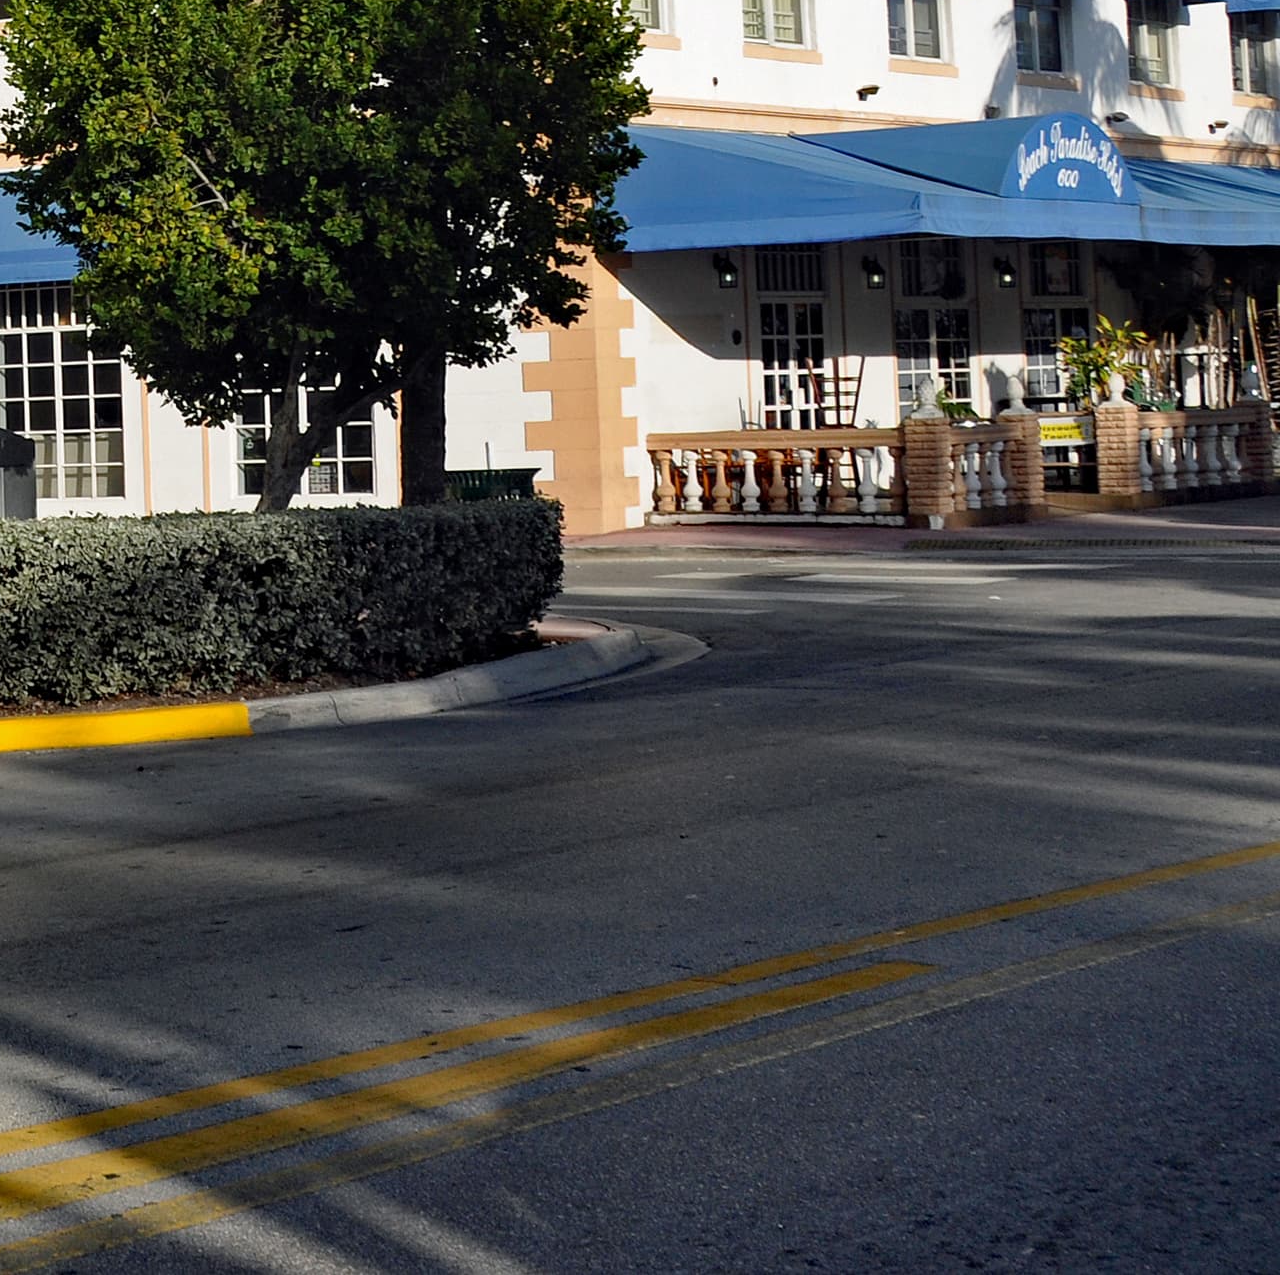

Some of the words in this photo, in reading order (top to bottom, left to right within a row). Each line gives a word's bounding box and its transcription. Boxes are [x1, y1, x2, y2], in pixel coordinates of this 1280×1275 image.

[1017, 129, 1049, 192] Beach
[1050, 121, 1098, 164] Paradise
[1097, 140, 1123, 198] Hotel
[1057, 168, 1079, 188] 600
